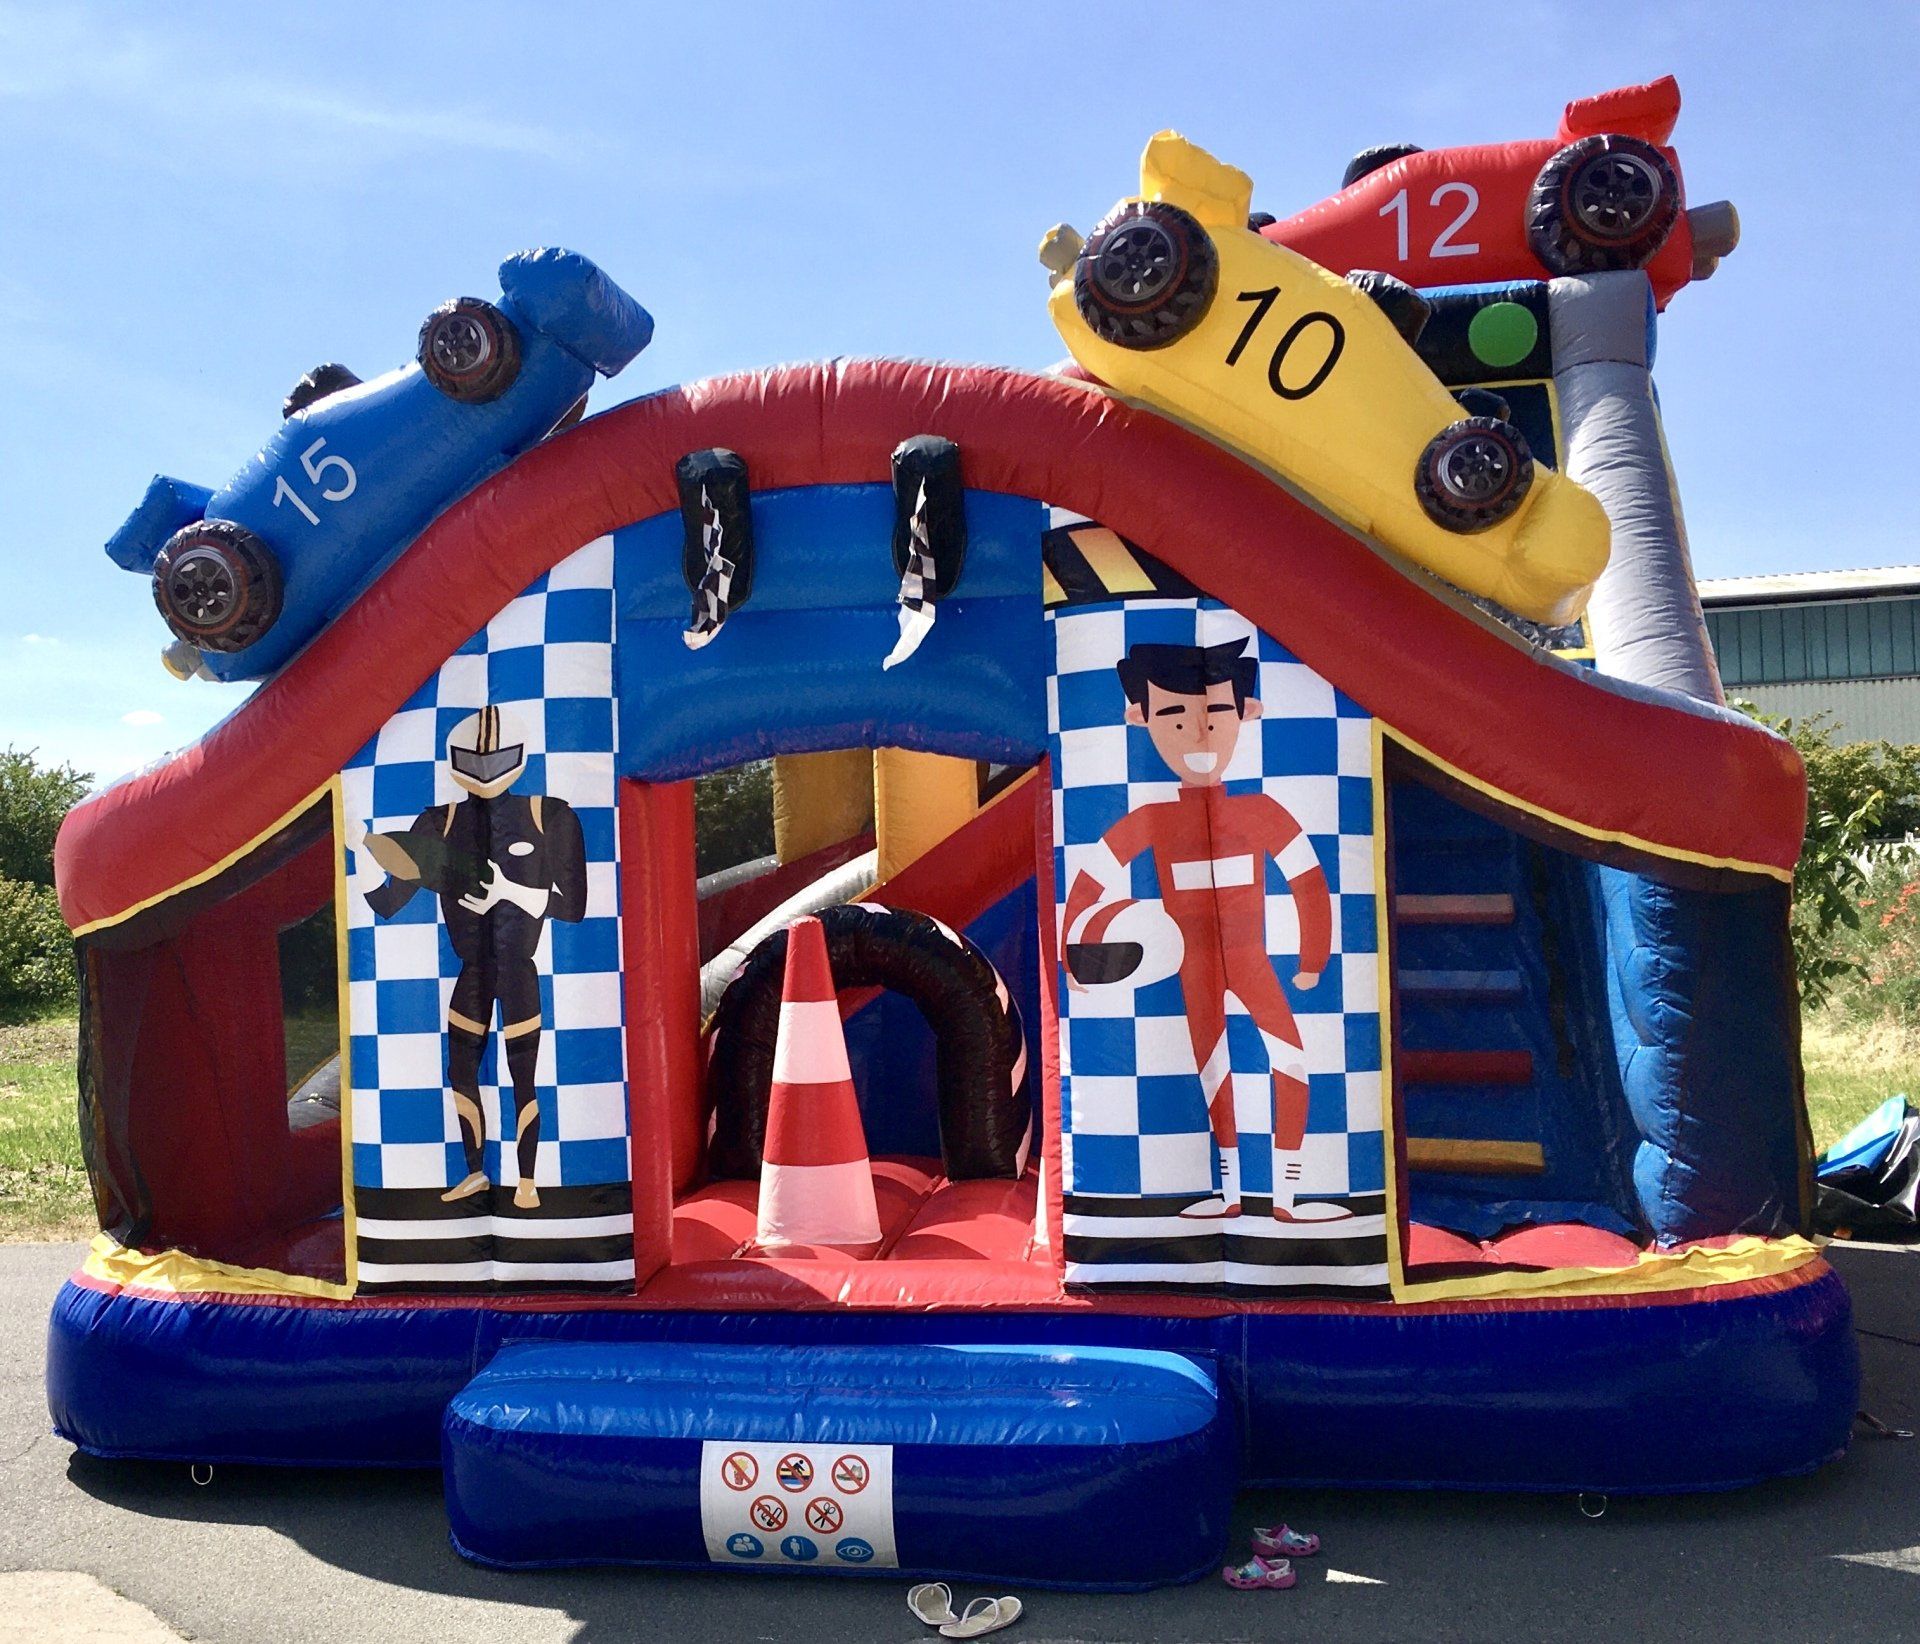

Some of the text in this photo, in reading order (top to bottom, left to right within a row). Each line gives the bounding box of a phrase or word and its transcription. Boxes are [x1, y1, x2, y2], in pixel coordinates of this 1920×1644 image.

[1379, 182, 1479, 260] 12
[1225, 286, 1344, 400] 10
[273, 437, 356, 525] 15
